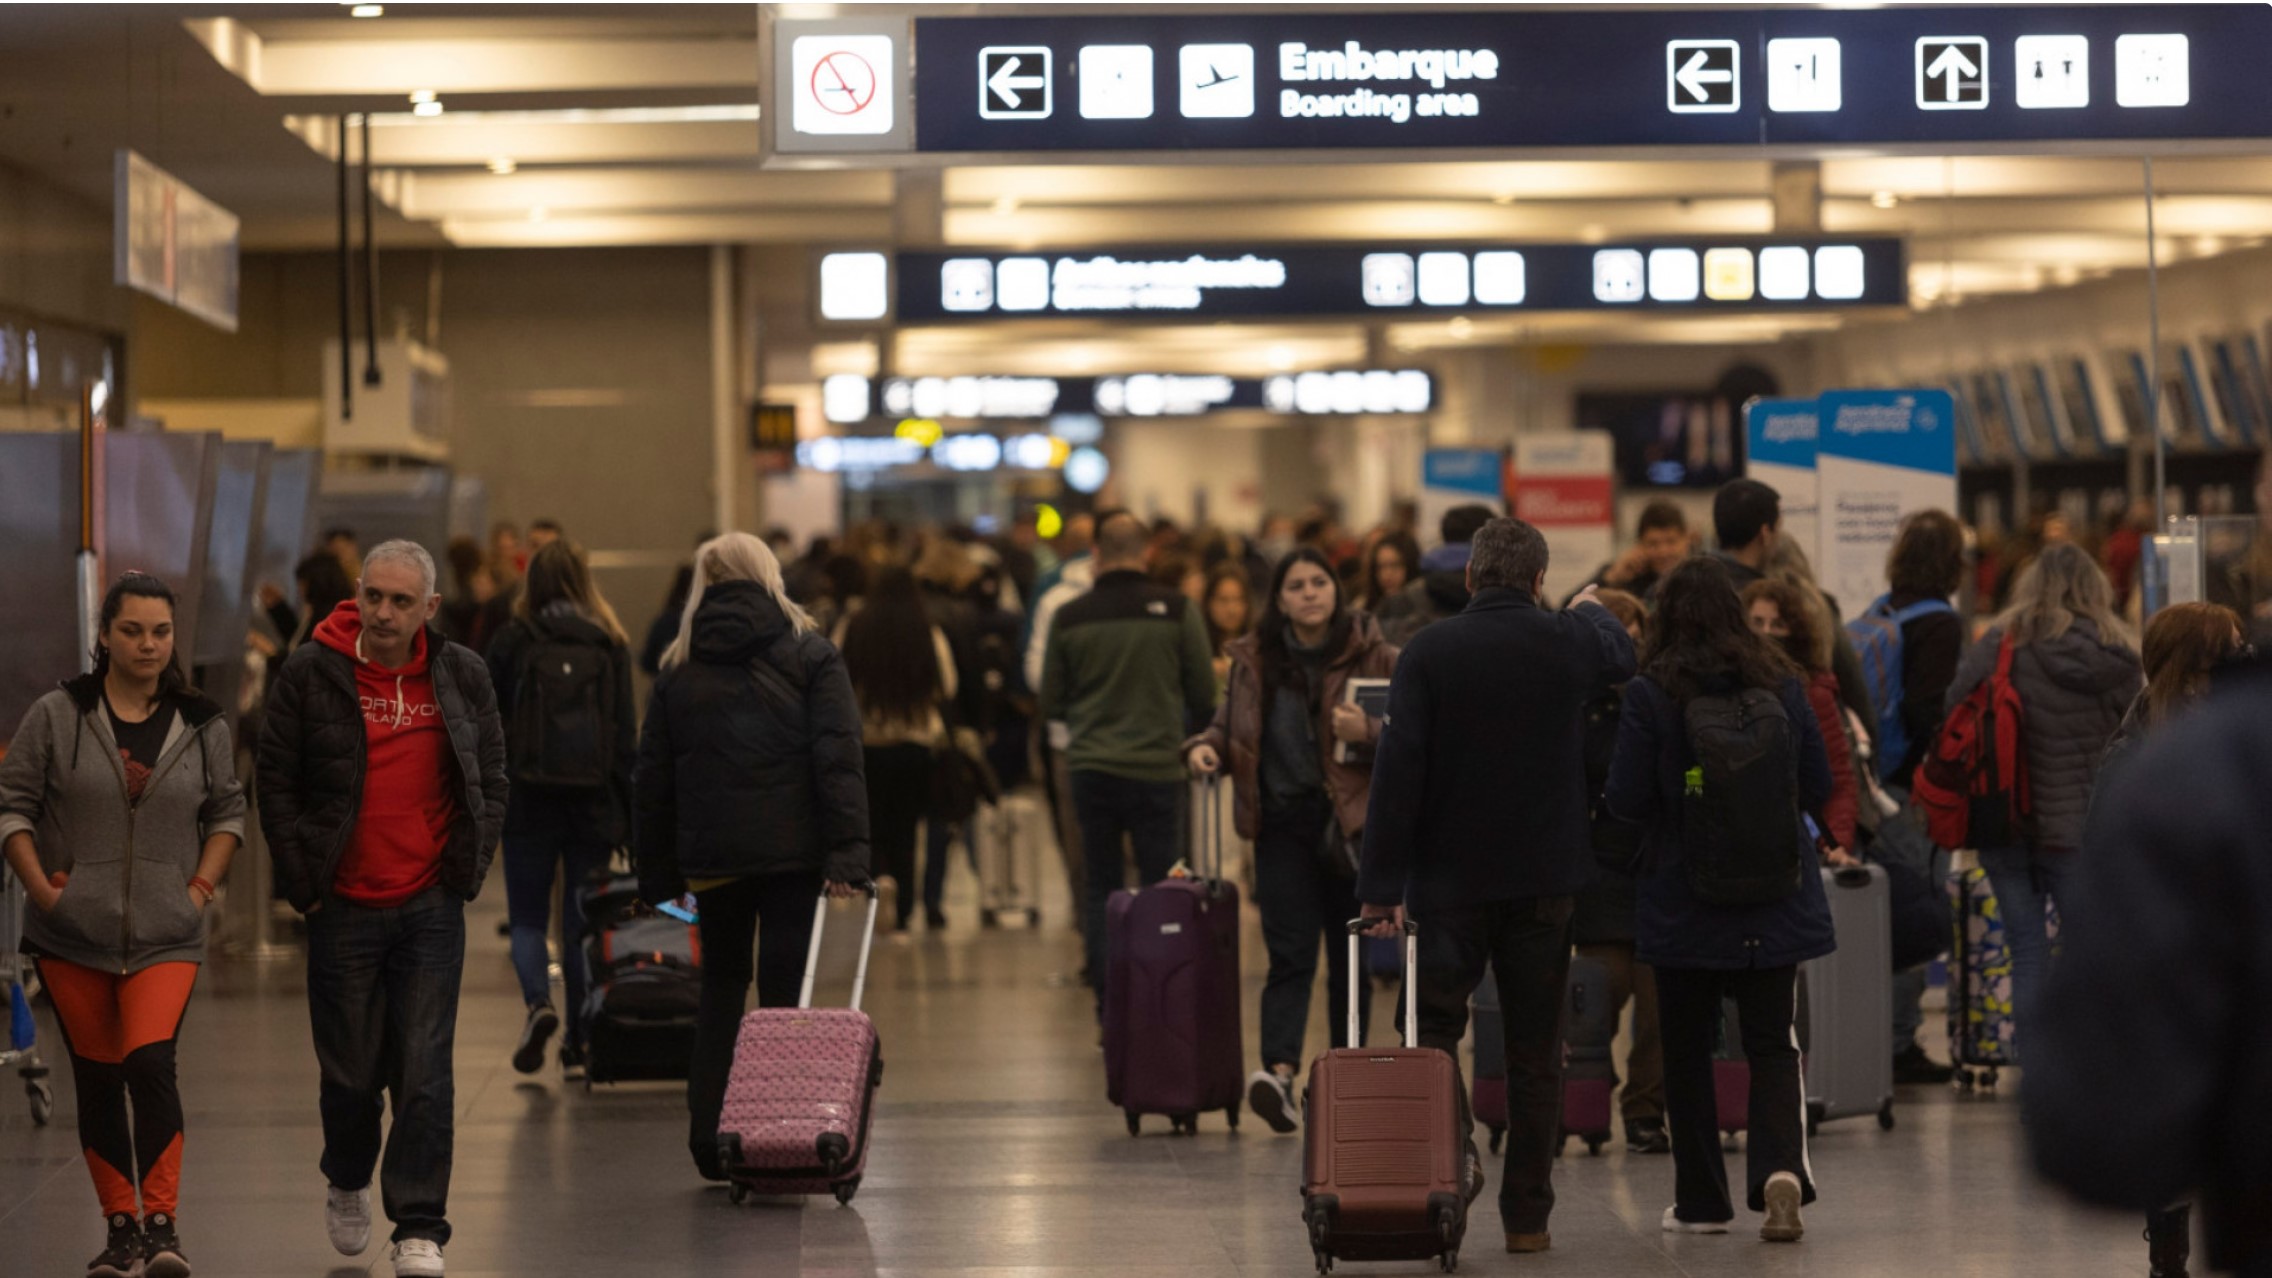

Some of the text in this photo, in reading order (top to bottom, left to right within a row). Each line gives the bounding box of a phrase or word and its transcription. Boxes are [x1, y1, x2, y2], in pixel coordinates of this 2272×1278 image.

[1279, 40, 1498, 88] Embarque
[1280, 87, 1479, 123] Boarding area
